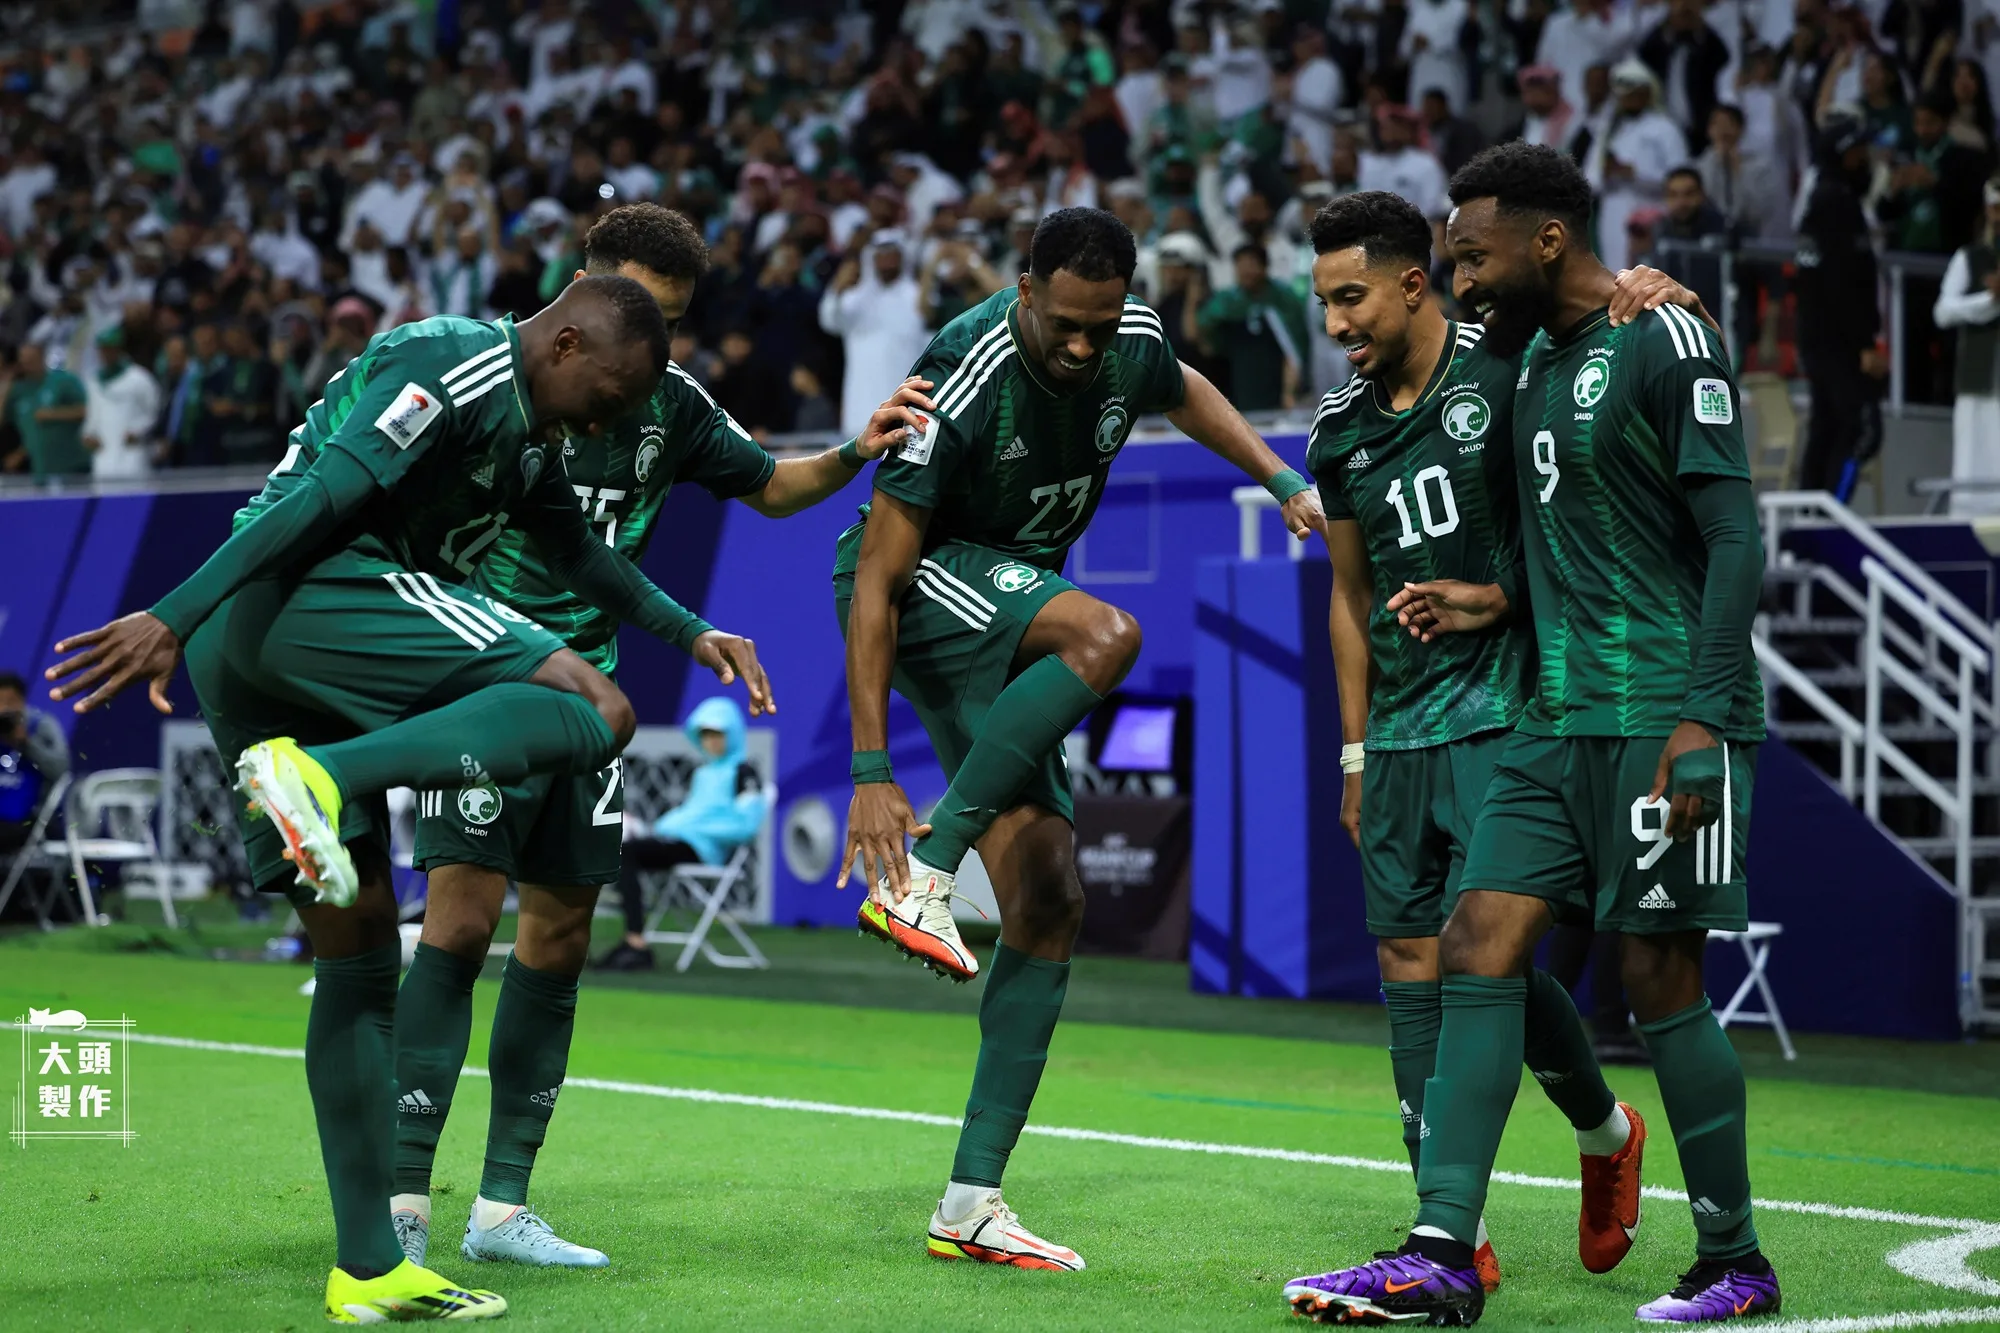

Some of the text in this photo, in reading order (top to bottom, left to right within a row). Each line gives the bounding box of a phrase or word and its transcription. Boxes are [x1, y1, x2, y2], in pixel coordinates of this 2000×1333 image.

[1441, 381, 1480, 397] السعودية
[1701, 384, 1717, 392] AFC
[1701, 392, 1727, 405] LIVE
[1701, 404, 1728, 413] LIVE
[1468, 418, 1483, 426] SAFF
[1000, 448, 1029, 461] adidas
[1458, 442, 1485, 455] SAUDI
[1532, 430, 1560, 503] 9
[1014, 474, 1092, 541] 23
[1385, 464, 1460, 549] 10
[592, 756, 624, 827] 2
[481, 806, 493, 814] SAFF
[464, 826, 488, 837] SAUDI
[1630, 795, 1674, 870] 9
[1638, 898, 1676, 909] adidas
[398, 1102, 438, 1115] didas
